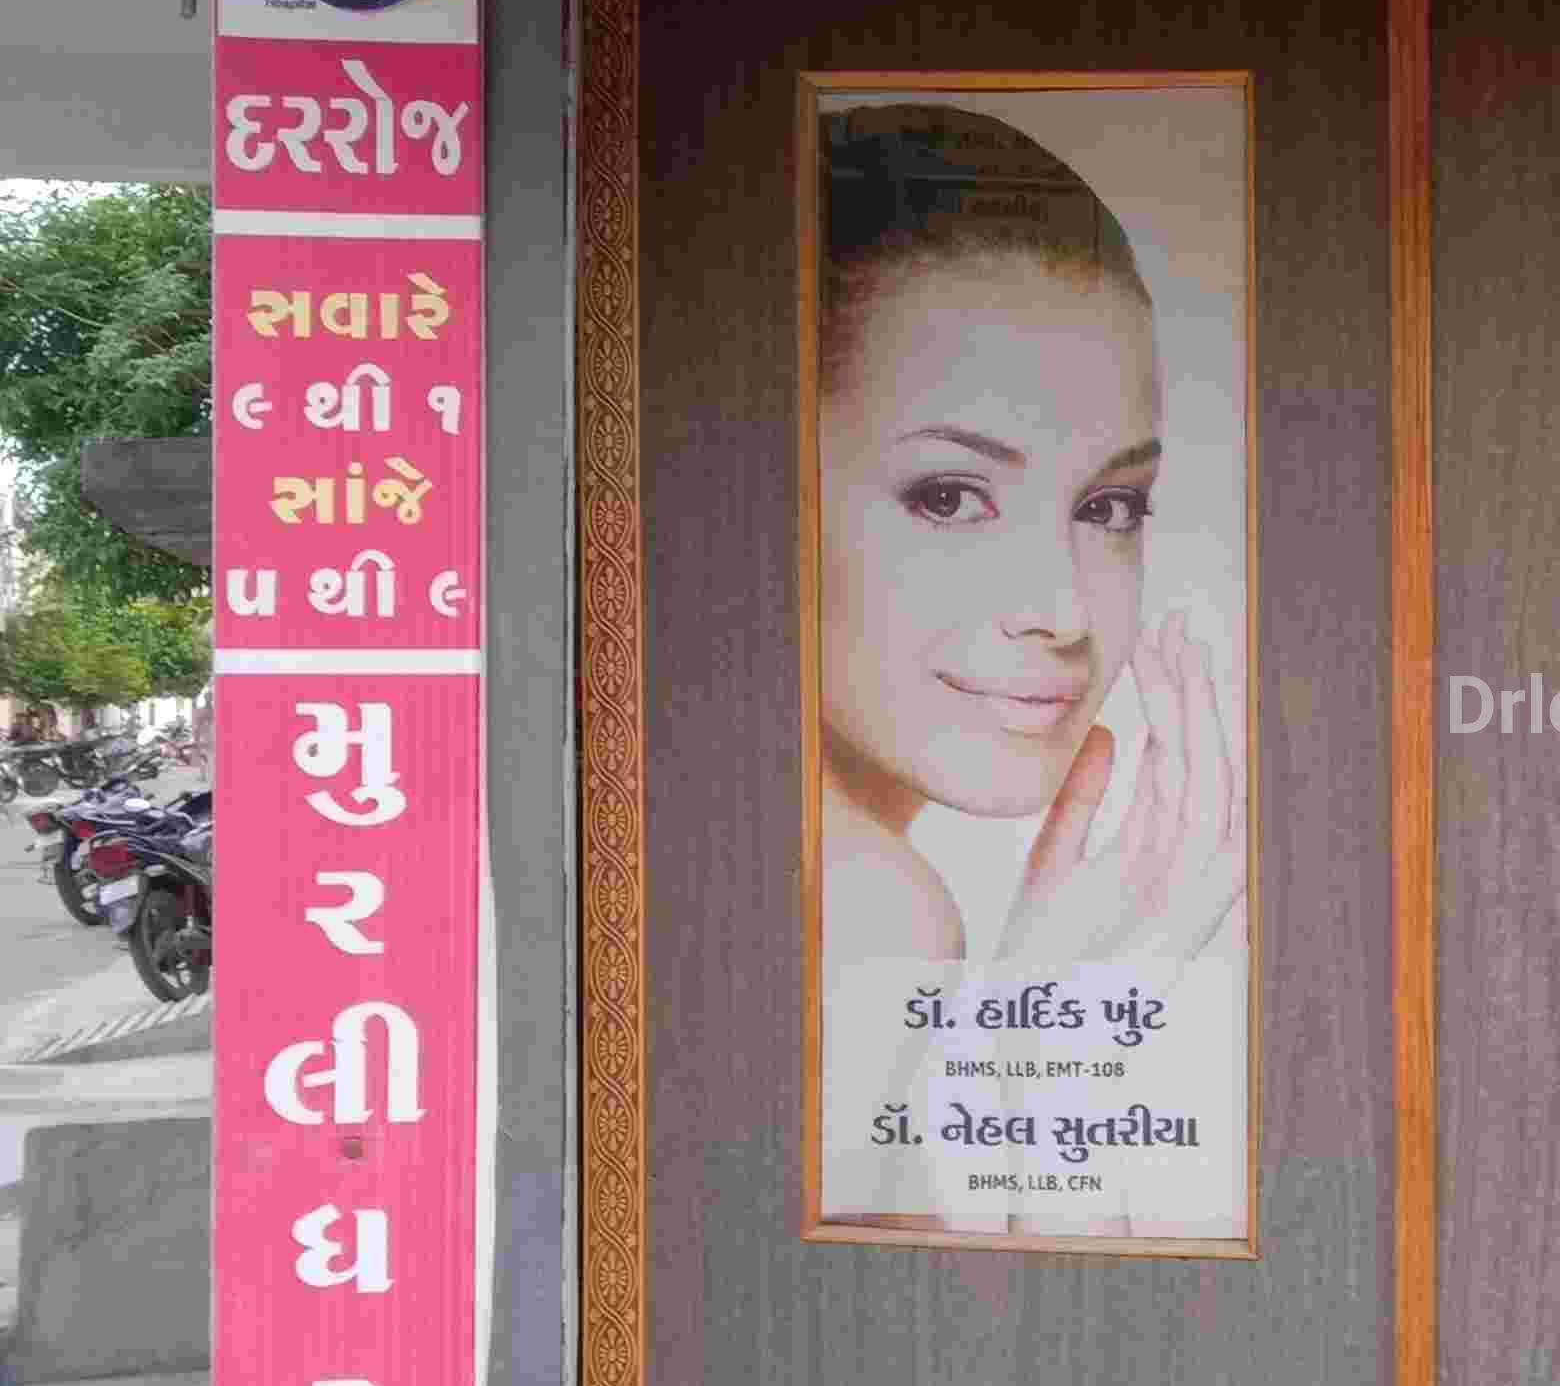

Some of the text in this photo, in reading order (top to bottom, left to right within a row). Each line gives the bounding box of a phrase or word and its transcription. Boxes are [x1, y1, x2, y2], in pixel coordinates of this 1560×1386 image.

[225, 59, 469, 176] દરરોજ
[246, 272, 449, 340] સવારે
[232, 363, 461, 435] ૯ થી ૧
[269, 456, 433, 524] સાંજે
[307, 549, 397, 618] થી
[428, 570, 467, 617] ૯
[975, 981, 1086, 1031] હાર્દિક
[1101, 986, 1167, 1048] ખુંટ
[945, 1060, 1126, 1080] BHMS, LLB, EMT-108
[940, 1102, 1037, 1147] નેહલ
[1052, 1103, 1200, 1164] સુતરીયા
[968, 1174, 1024, 1194] BHMS,
[1067, 1174, 1103, 1192] CFN
